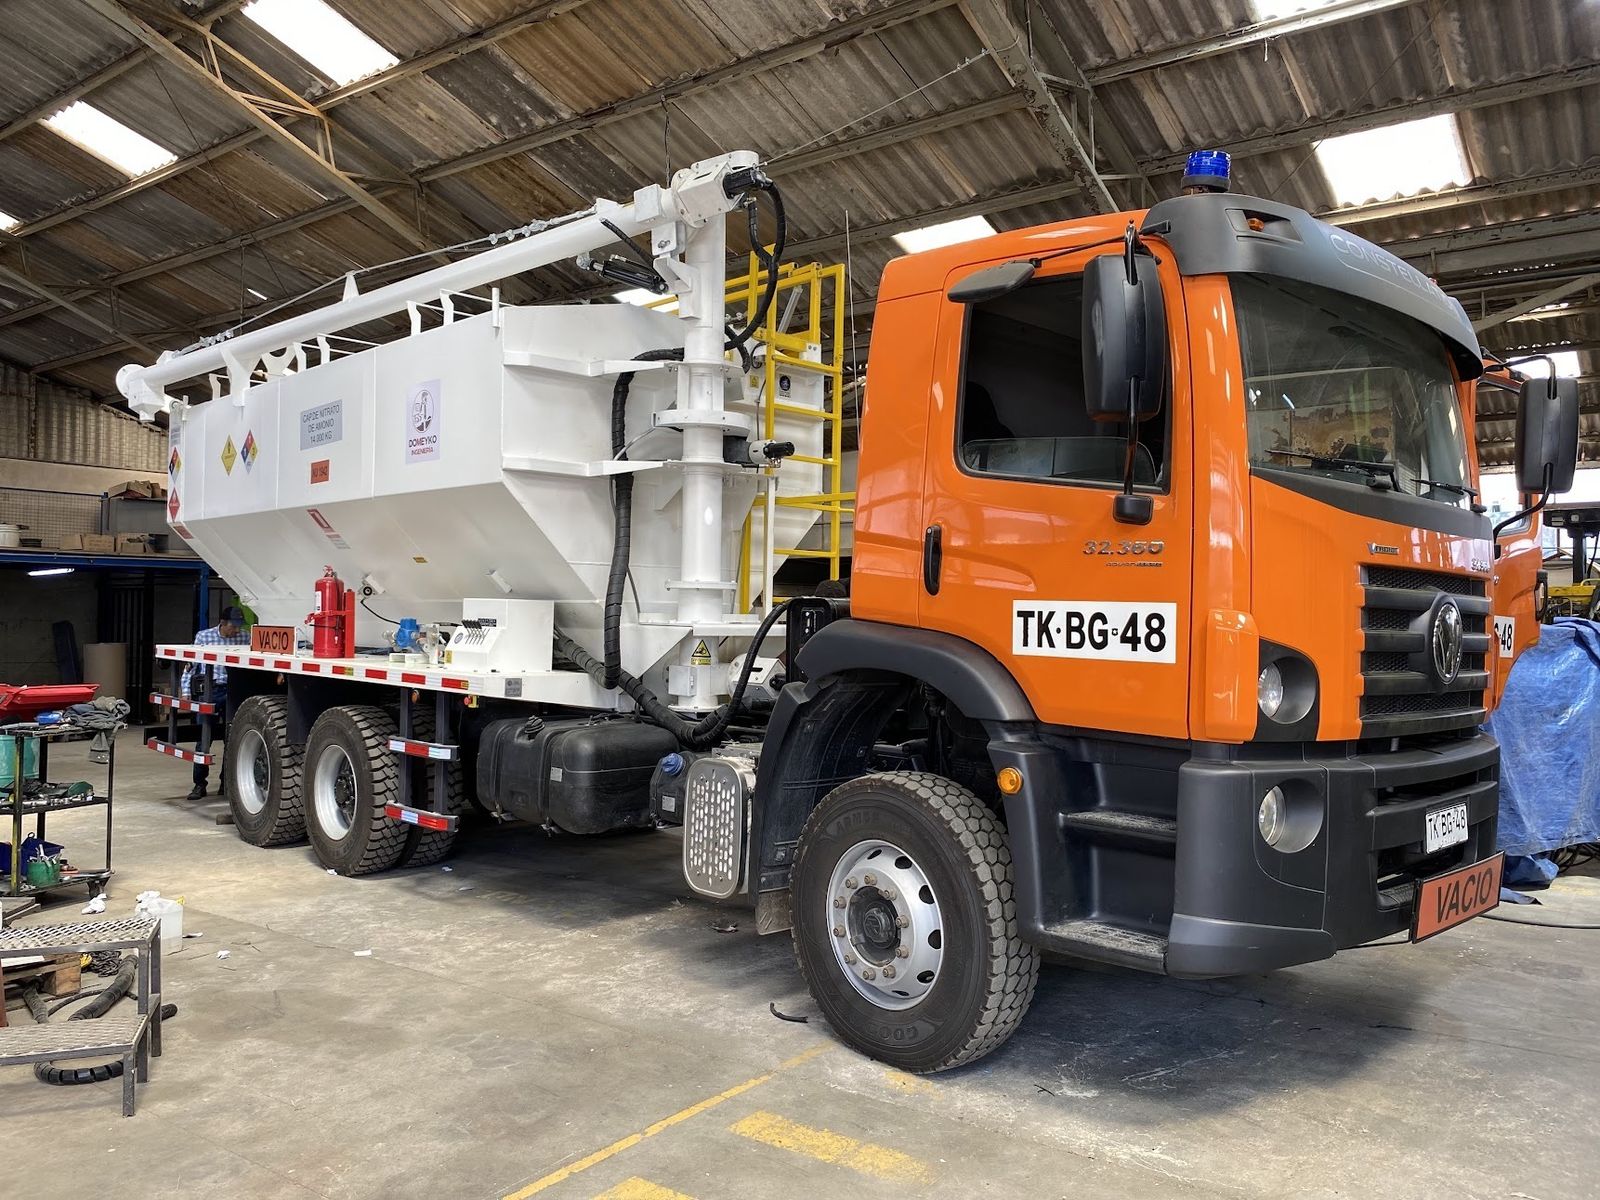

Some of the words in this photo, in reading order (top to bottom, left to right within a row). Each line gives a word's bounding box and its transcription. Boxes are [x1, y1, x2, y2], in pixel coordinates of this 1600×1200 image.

[408, 434, 438, 448] DOMEYKO
[1082, 540, 1164, 556] 32.360
[258, 630, 289, 651] VACIO
[1437, 867, 1493, 924] VACIO
